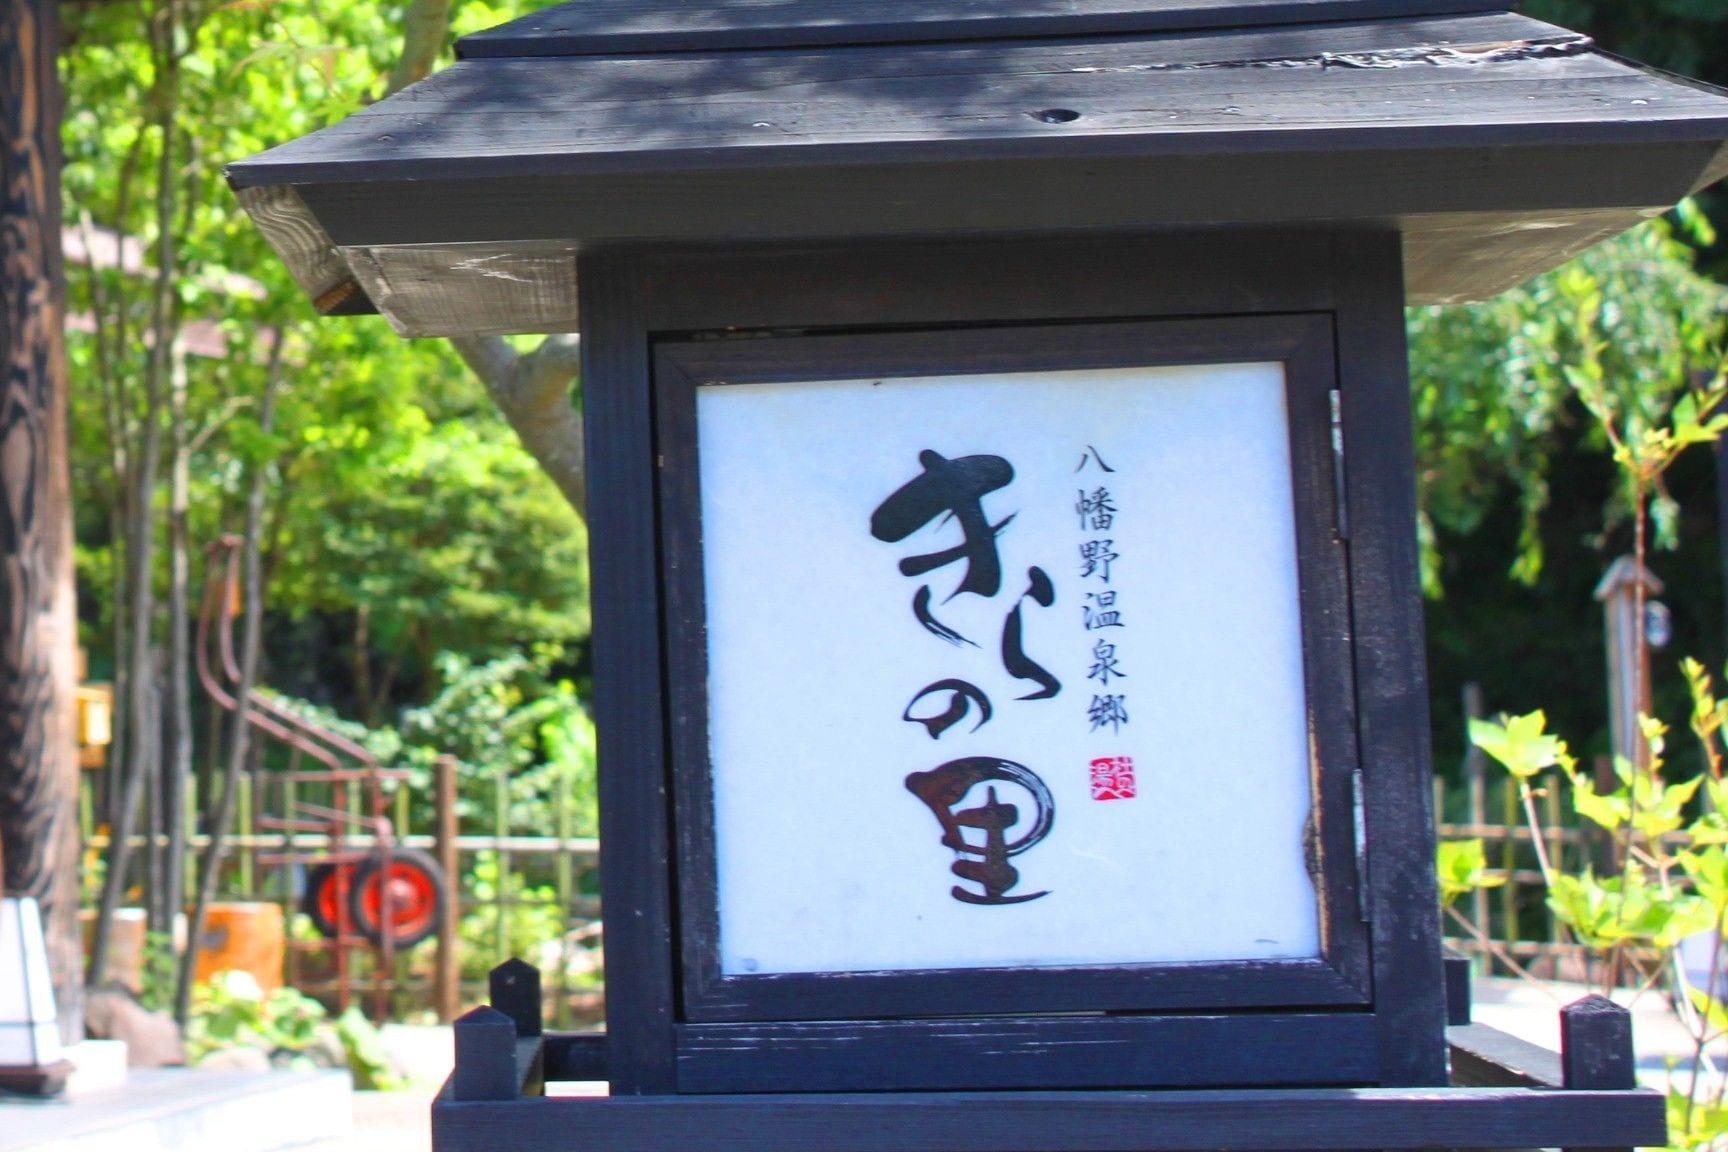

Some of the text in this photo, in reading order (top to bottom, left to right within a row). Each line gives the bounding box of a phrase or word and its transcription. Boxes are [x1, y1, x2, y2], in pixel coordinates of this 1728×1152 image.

[871, 449, 1062, 905] きらの里
[1075, 445, 1129, 735] 八幡野温泉郷
